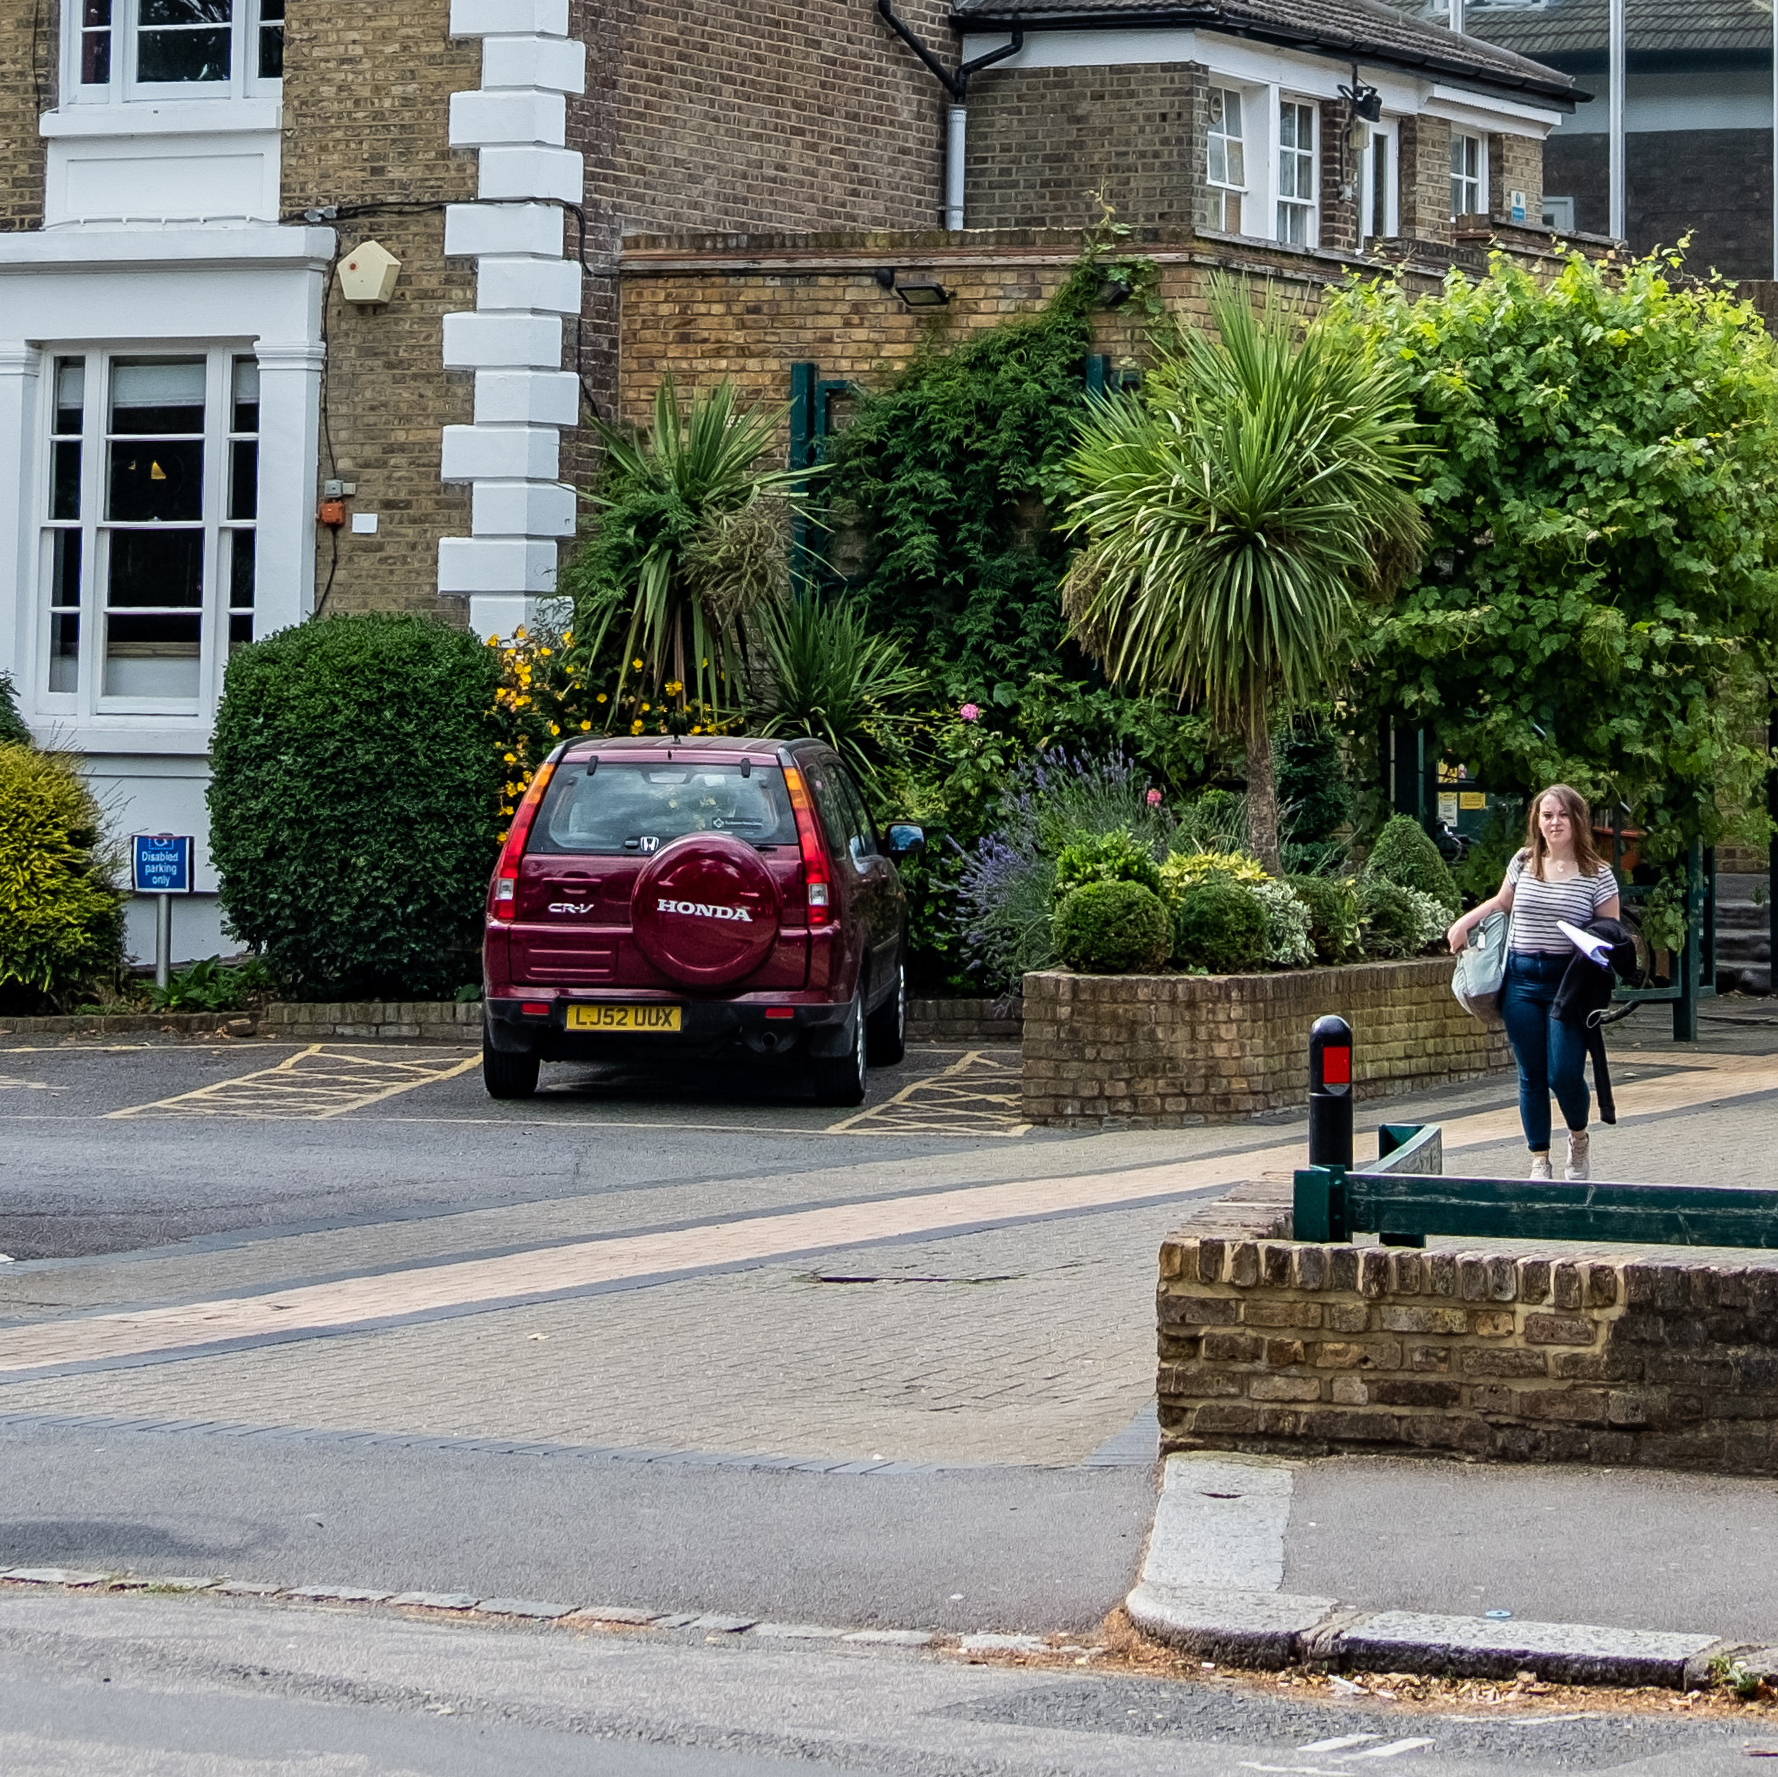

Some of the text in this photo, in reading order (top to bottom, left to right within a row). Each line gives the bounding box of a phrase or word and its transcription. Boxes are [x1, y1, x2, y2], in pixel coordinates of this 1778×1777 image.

[141, 850, 179, 862] Disabled
[144, 862, 177, 875] parking
[151, 874, 170, 887] only
[547, 902, 594, 914] CR-V
[656, 898, 753, 922] HONDA
[575, 1006, 674, 1028] LJ52 UUX
